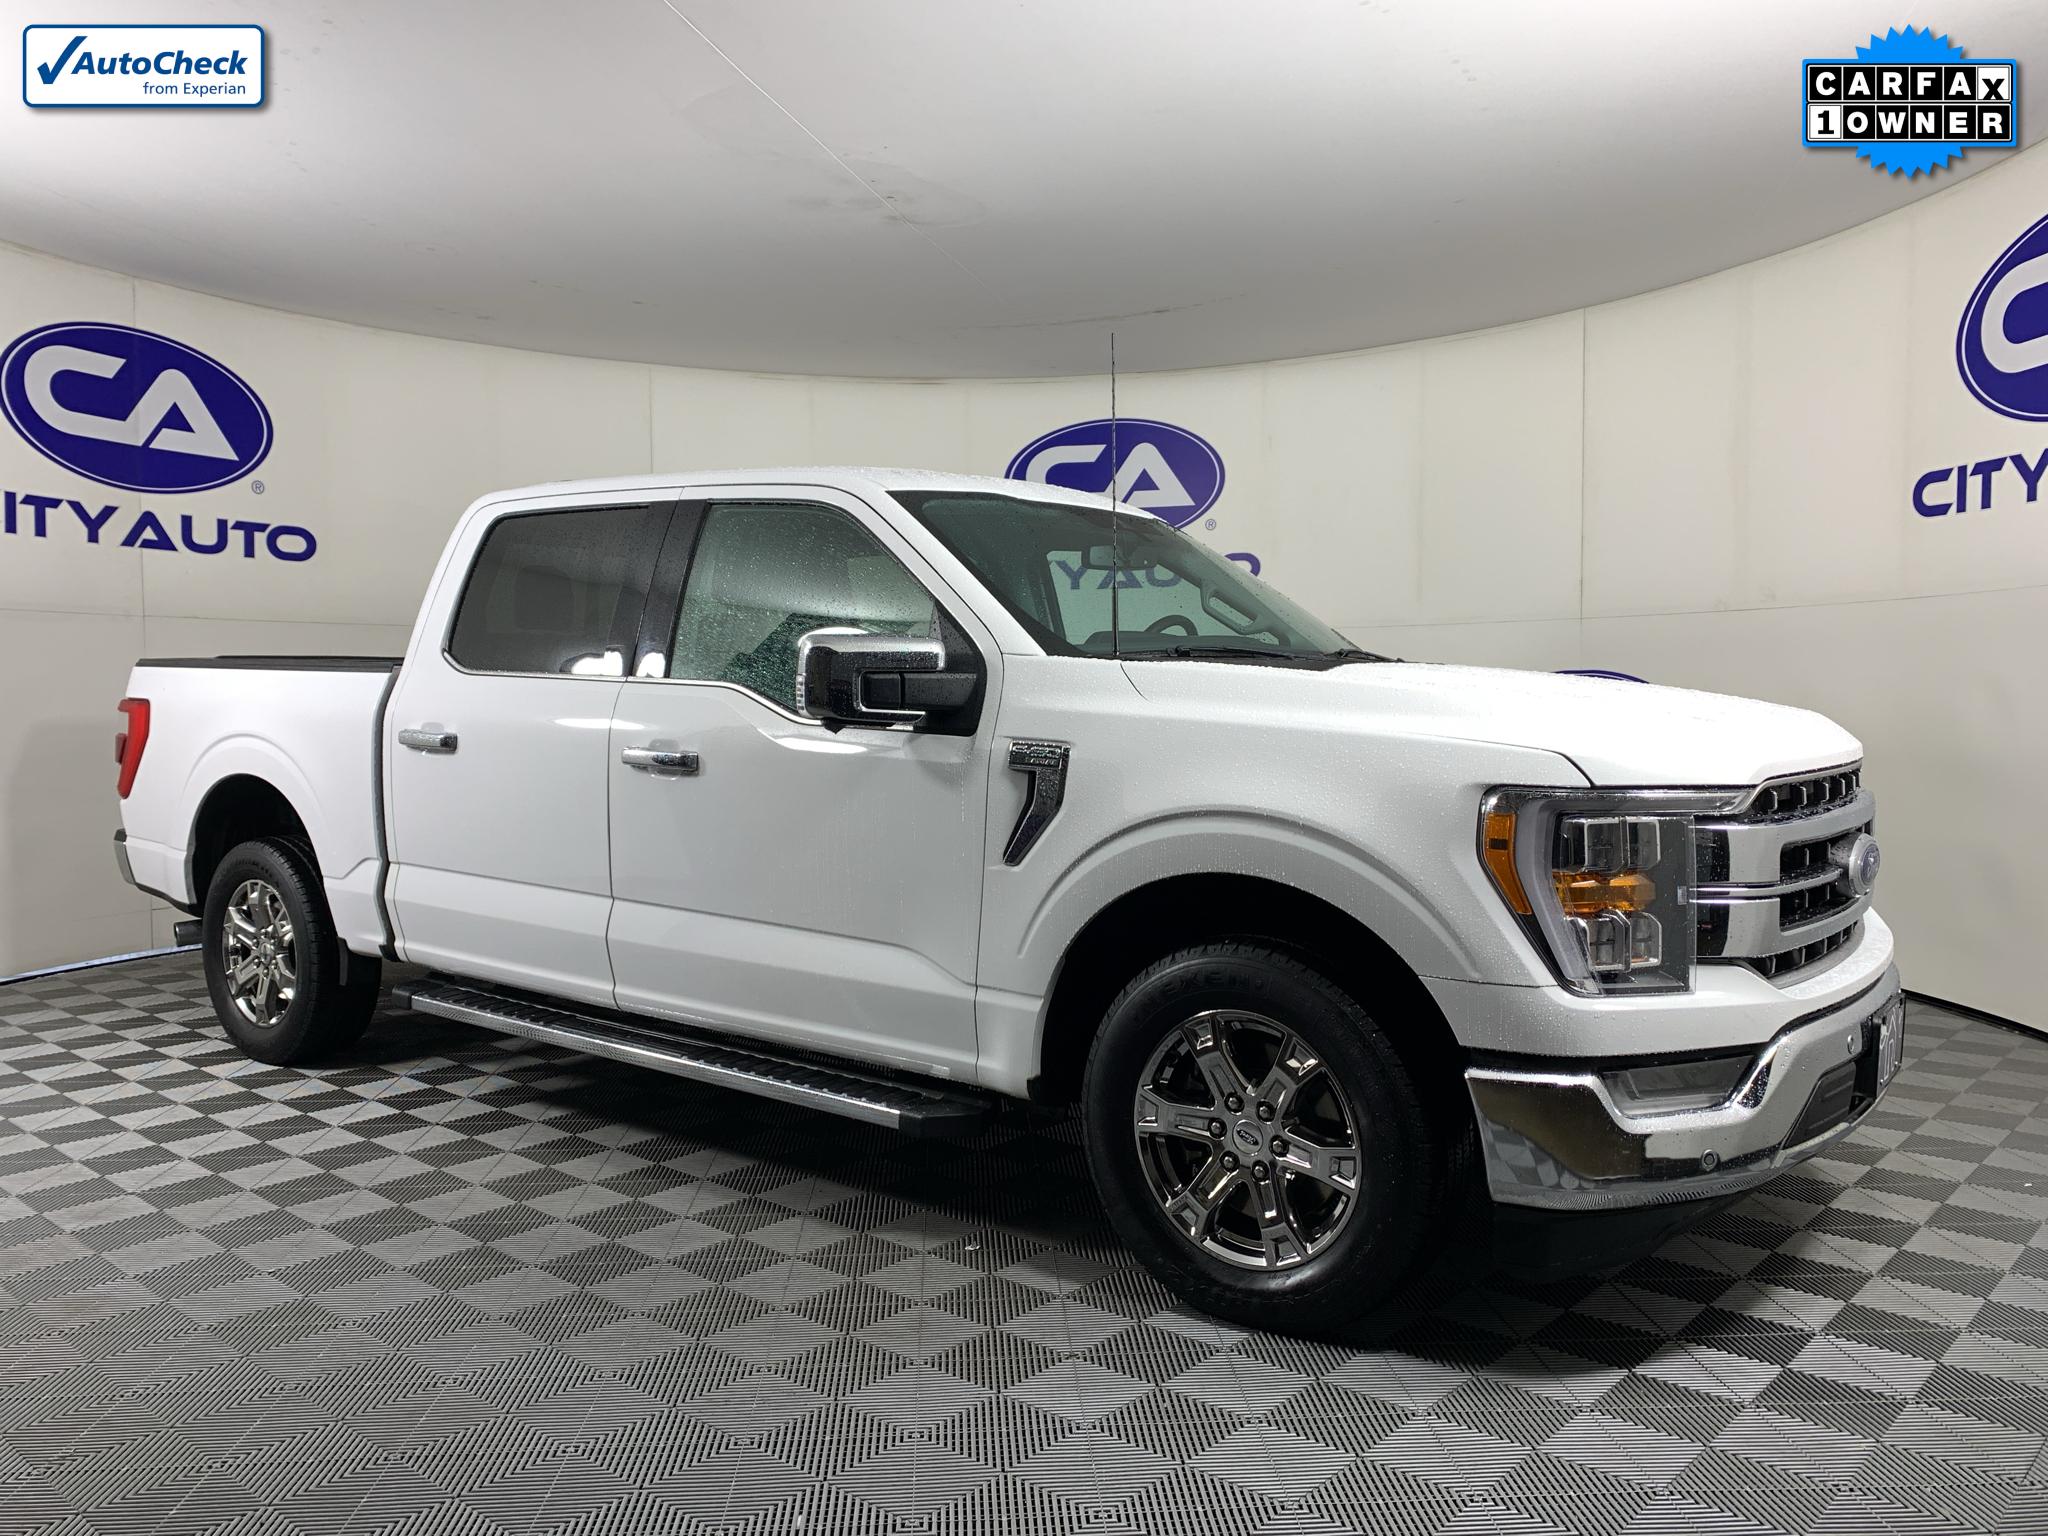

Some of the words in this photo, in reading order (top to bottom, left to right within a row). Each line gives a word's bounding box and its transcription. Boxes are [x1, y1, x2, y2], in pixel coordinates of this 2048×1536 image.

[23, 344, 240, 461] CA
[4, 490, 119, 544] ITY
[1912, 448, 2048, 518] CITY
